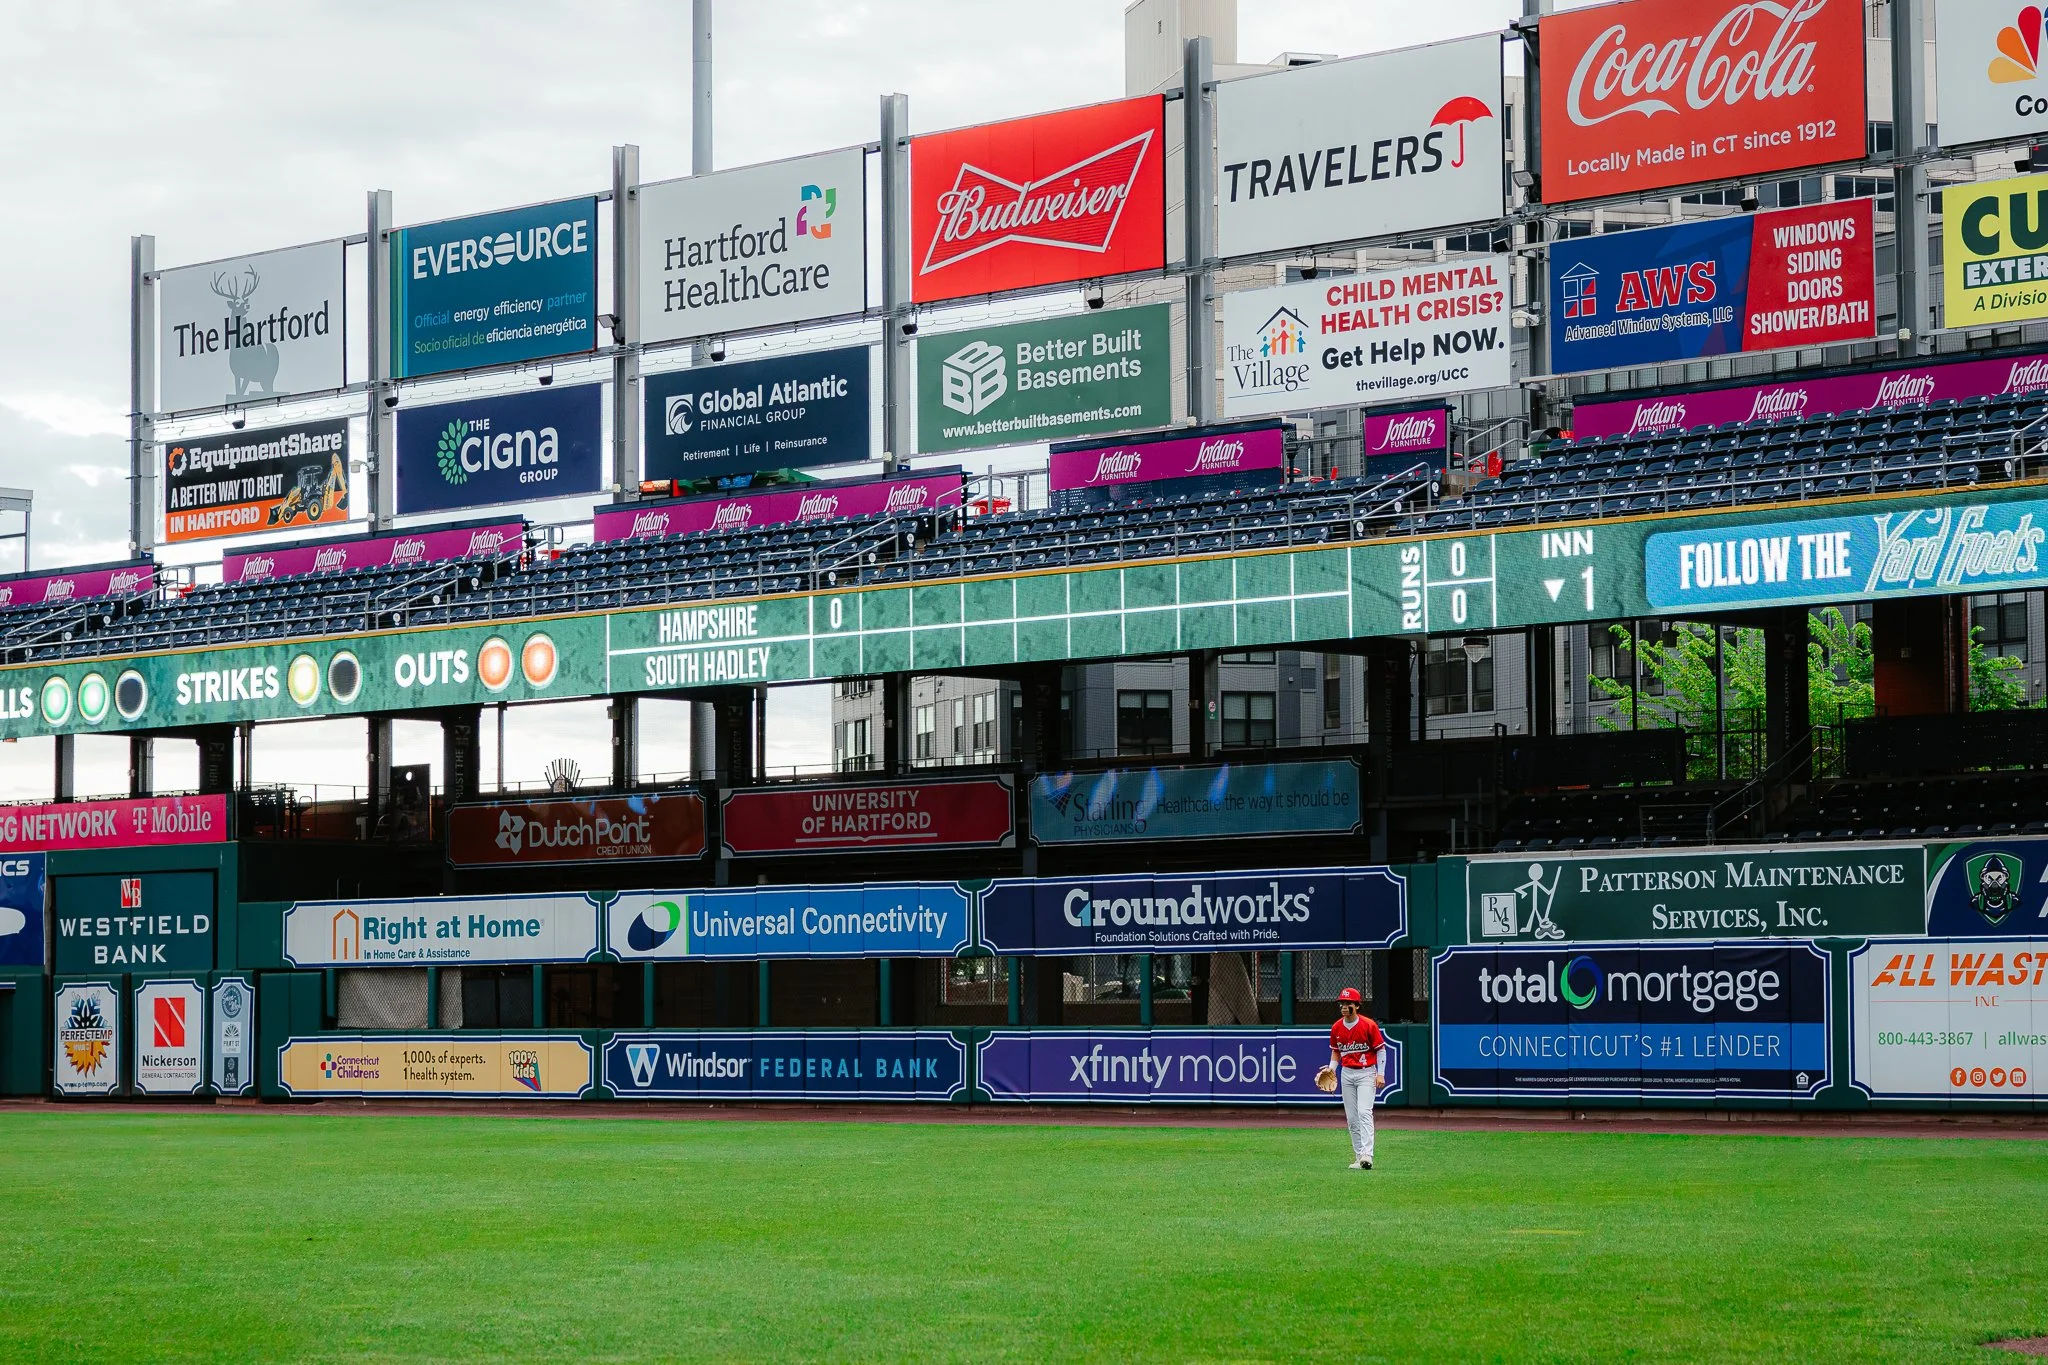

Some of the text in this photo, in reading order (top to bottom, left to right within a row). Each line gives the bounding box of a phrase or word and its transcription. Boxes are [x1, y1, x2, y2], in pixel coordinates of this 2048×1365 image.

[1566, 0, 1828, 127] Coca-Cola
[1568, 119, 1836, 176] Locally Made in CT since 1912
[1223, 131, 1443, 202] TRAVELERS
[937, 178, 1127, 242] Budweiser
[413, 220, 587, 279] EVERSOURCE
[664, 217, 787, 271] Hartford
[1773, 217, 1856, 249] WINDOWS
[1787, 247, 1841, 275] SIDING
[664, 263, 829, 312] HealthCare
[1326, 265, 1498, 306] CHILD MENTAL
[1615, 261, 1716, 313] AWS
[1788, 276, 1842, 302] DOORS
[1974, 289, 2047, 311] A Divisio
[414, 292, 586, 328] Official energy efficiency partner
[1321, 292, 1504, 335] HEALTH CRISIS?
[1565, 306, 1733, 341] Advanced Window Systems, LLC
[1751, 300, 1869, 335] SHOWER/BATH
[174, 300, 329, 357] The Hartford
[415, 317, 586, 354] Socio oficial de eficiencia energética
[1017, 329, 1142, 365] Better Built
[1227, 344, 1253, 362] The
[1322, 327, 1505, 370] Get Help NOW.
[1017, 356, 1142, 391] Basements
[1234, 359, 1310, 392] Village
[1356, 368, 1469, 391] thevillage.org/UCC
[699, 375, 848, 415] Global Atlantic
[469, 418, 490, 431] THE
[700, 408, 806, 431] FINANCIAL GROUP
[943, 404, 1142, 439] www.betterbuiltbasements.com
[1372, 417, 1435, 450] Jordan's
[190, 432, 342, 473] EquipmentShare
[683, 436, 828, 461] Retirement Life Reinsurance
[1185, 440, 1244, 471] Jordan's
[519, 468, 558, 483] GROUP
[1085, 451, 1141, 482] Jordan's
[171, 474, 283, 508] A BETTER WAY TO RENT
[171, 506, 259, 533] IN HARTFORD
[1451, 541, 1466, 576] 0
[1542, 530, 1593, 558] INN
[1680, 505, 2045, 593] FOLLOW THE Yard Goats
[1401, 546, 1421, 630] RUNS
[1581, 566, 1594, 611] 1
[830, 598, 842, 629] 0
[1452, 588, 1467, 624] 0
[660, 605, 758, 644] HAMPSHIRE
[395, 649, 469, 688] OUTS
[646, 647, 770, 686] SOUTH HADLEY
[176, 666, 280, 706] STRIKES
[812, 790, 920, 812] UNIVERSITY
[1224, 794, 1248, 812] the
[1248, 793, 1273, 812] way
[1275, 792, 1284, 807] it
[1287, 789, 1331, 808] should
[1332, 790, 1349, 806] be
[22, 809, 117, 842] NETWORK
[152, 805, 211, 833] Mobile
[529, 815, 650, 848] Dutch Point
[802, 812, 931, 834] OF HARTFORD
[597, 844, 652, 855] CREDIT UNION
[693, 904, 947, 939] Universal Connectivity
[1064, 882, 1310, 927] Groundworks
[60, 914, 209, 937] WESTFIELD
[363, 914, 540, 945] Right at Home
[1095, 929, 1280, 943] Foundation Solutions Crafted with Pride.
[94, 944, 167, 965] BANK
[364, 948, 470, 960] In Home Care & Assistance
[1871, 952, 2048, 986] ALL WAST
[1479, 960, 1779, 1013] total mortgage
[1975, 996, 2000, 1007] INC
[1479, 1034, 1780, 1058] CONNECTICUT'S #1 LENDER
[1878, 1032, 1973, 1045] 800-443-3867
[142, 1055, 196, 1067] Nickerson
[337, 1055, 379, 1065] Connecticut
[402, 1051, 486, 1068] 1,000s of experts.
[509, 1050, 537, 1065] 100%
[665, 1052, 938, 1078] Windsor FEDERAL BANK
[1070, 1044, 1296, 1088] xfinity mobile
[404, 1068, 474, 1084] 1 health system.
